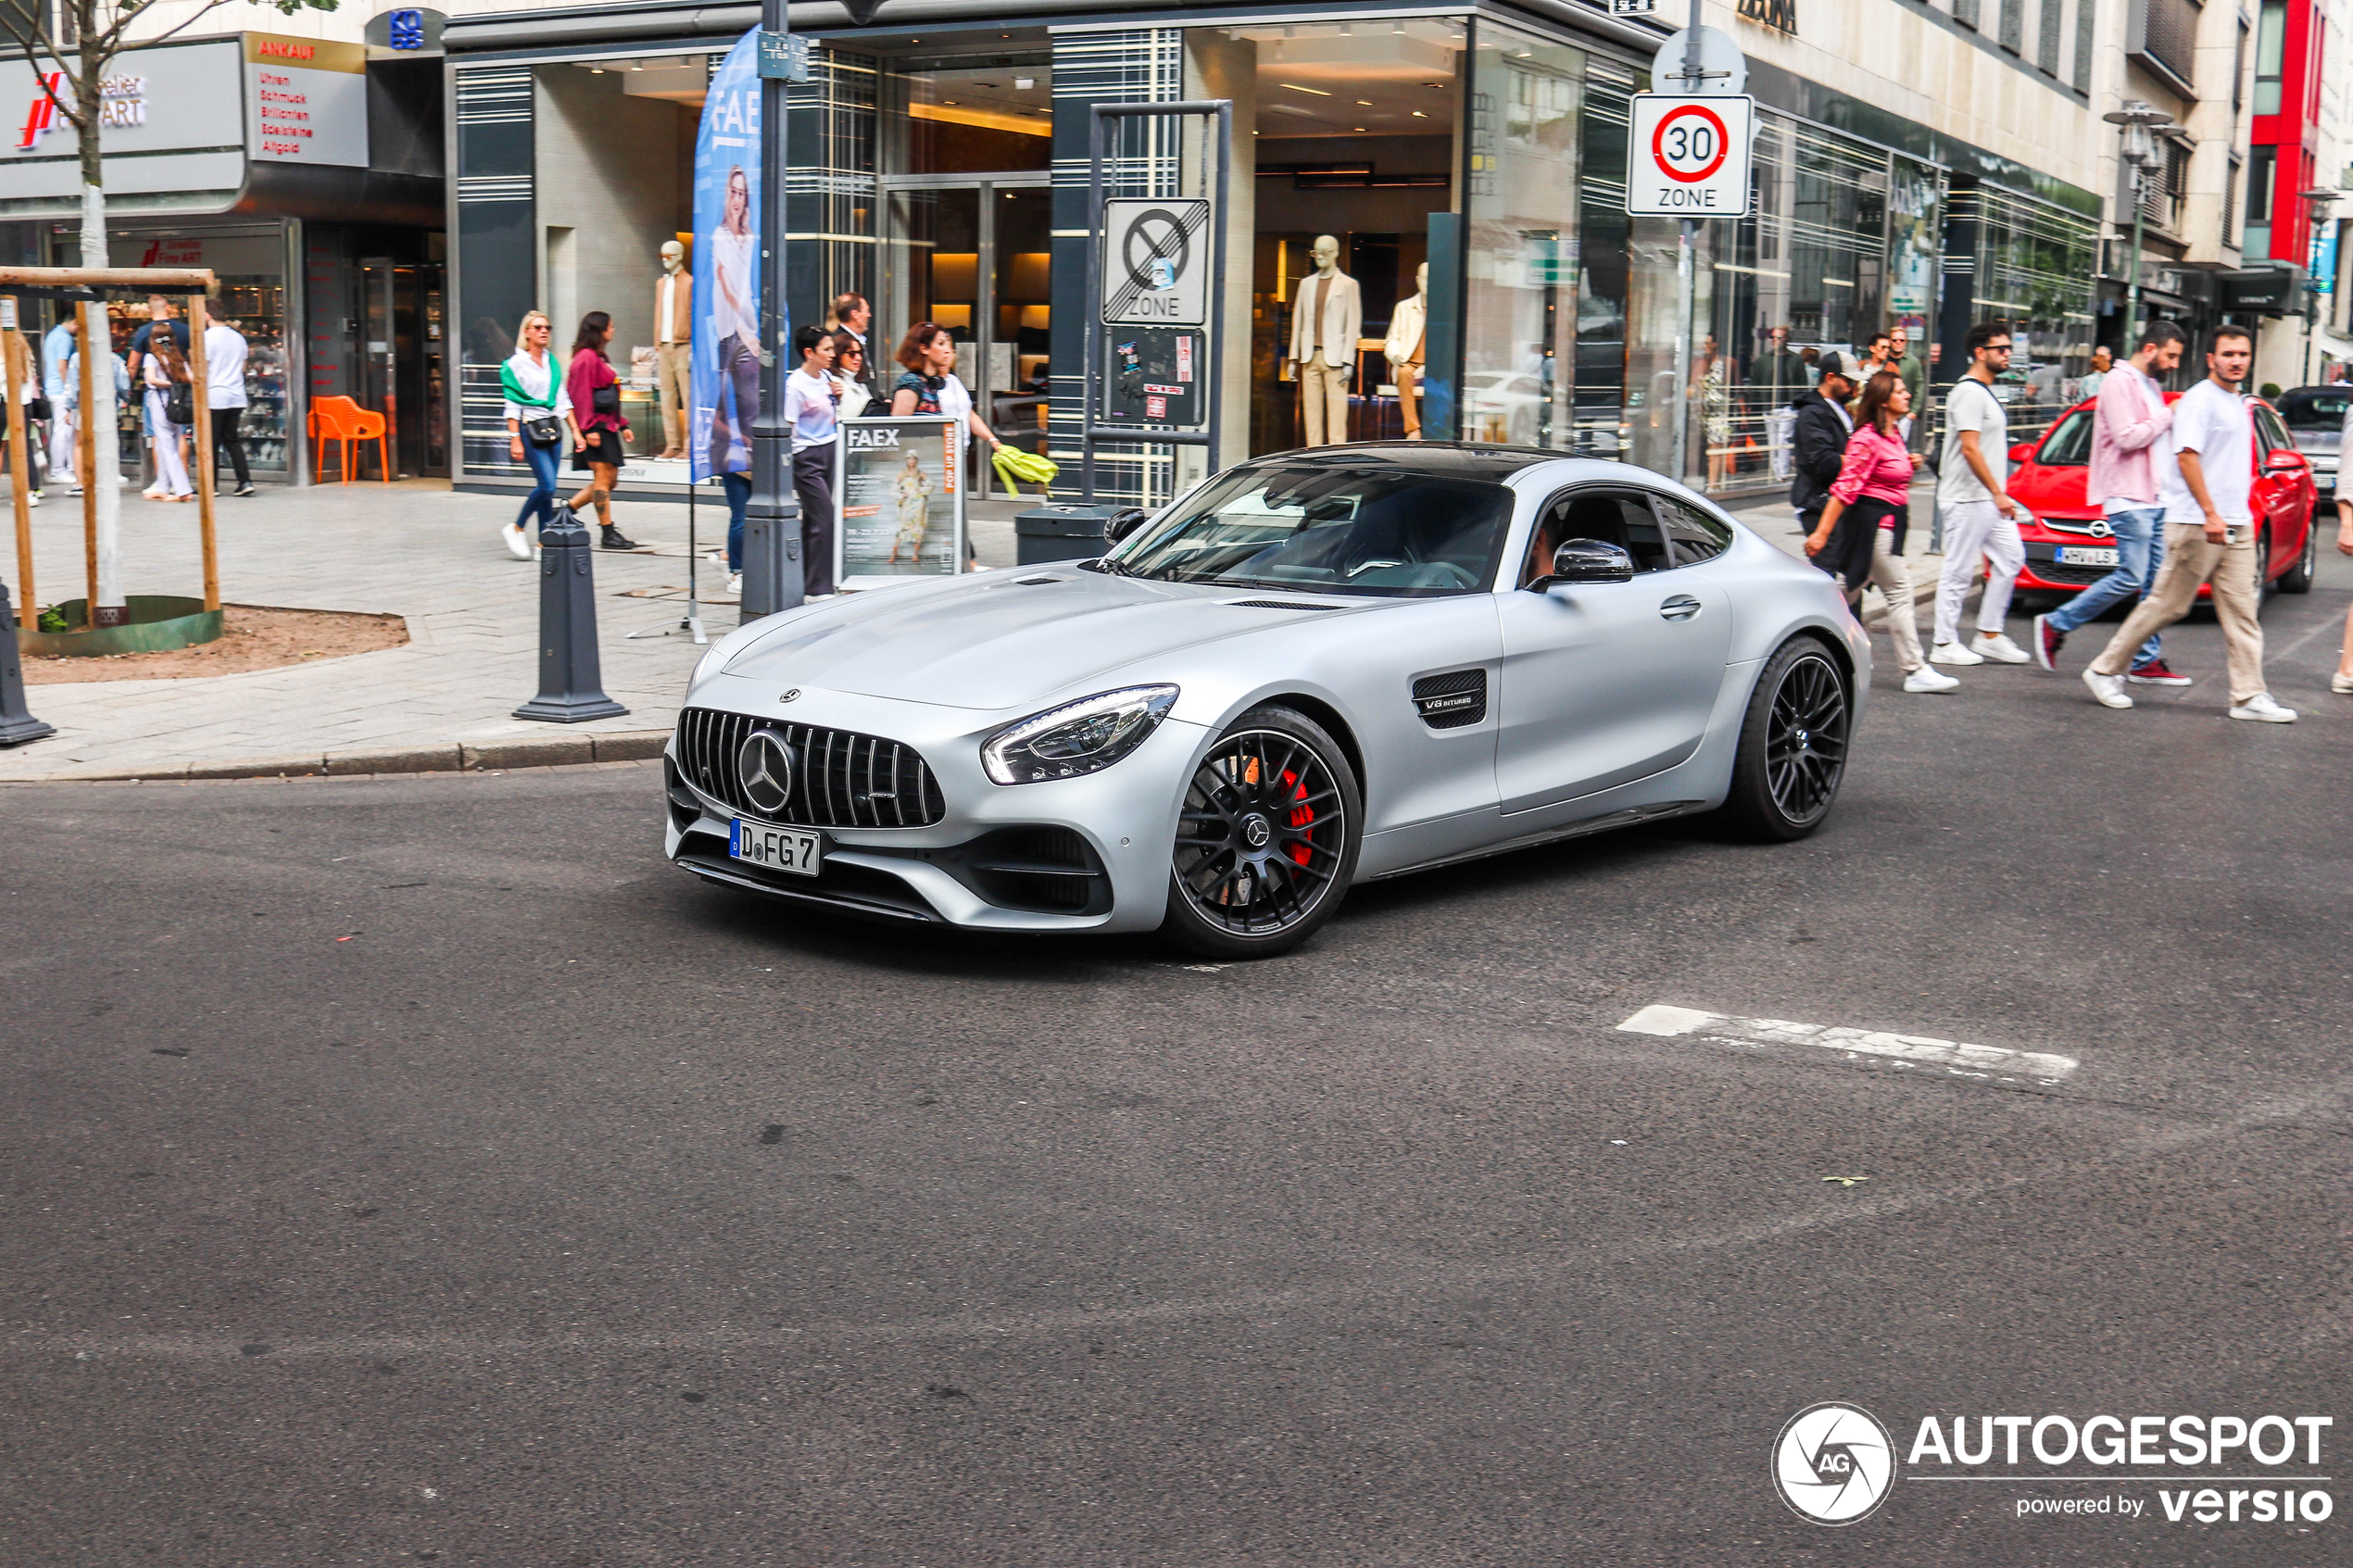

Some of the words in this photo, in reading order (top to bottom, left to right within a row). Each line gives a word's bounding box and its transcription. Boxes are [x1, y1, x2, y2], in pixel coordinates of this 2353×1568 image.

[259, 41, 315, 60] ANKAUF
[259, 73, 290, 85] Uhren
[261, 89, 307, 104] Schmuck
[102, 98, 143, 125] ART
[261, 106, 309, 120] Brillanten
[711, 90, 761, 134] FAE
[261, 122, 313, 137] Edelsteine
[262, 141, 299, 155] Altgold
[1667, 127, 1711, 161] 30
[1658, 188, 1717, 207] ZONE
[1129, 296, 1179, 317] ZONE
[848, 429, 900, 446] FAEX
[945, 427, 954, 454] STORE
[945, 456, 954, 468] UP
[945, 470, 954, 488] POP
[1426, 699, 1443, 709] V8
[1443, 697, 1472, 707] BITURBO
[733, 841, 738, 851] D
[742, 825, 753, 858] D
[764, 832, 794, 867] FG
[799, 837, 815, 869] 7
